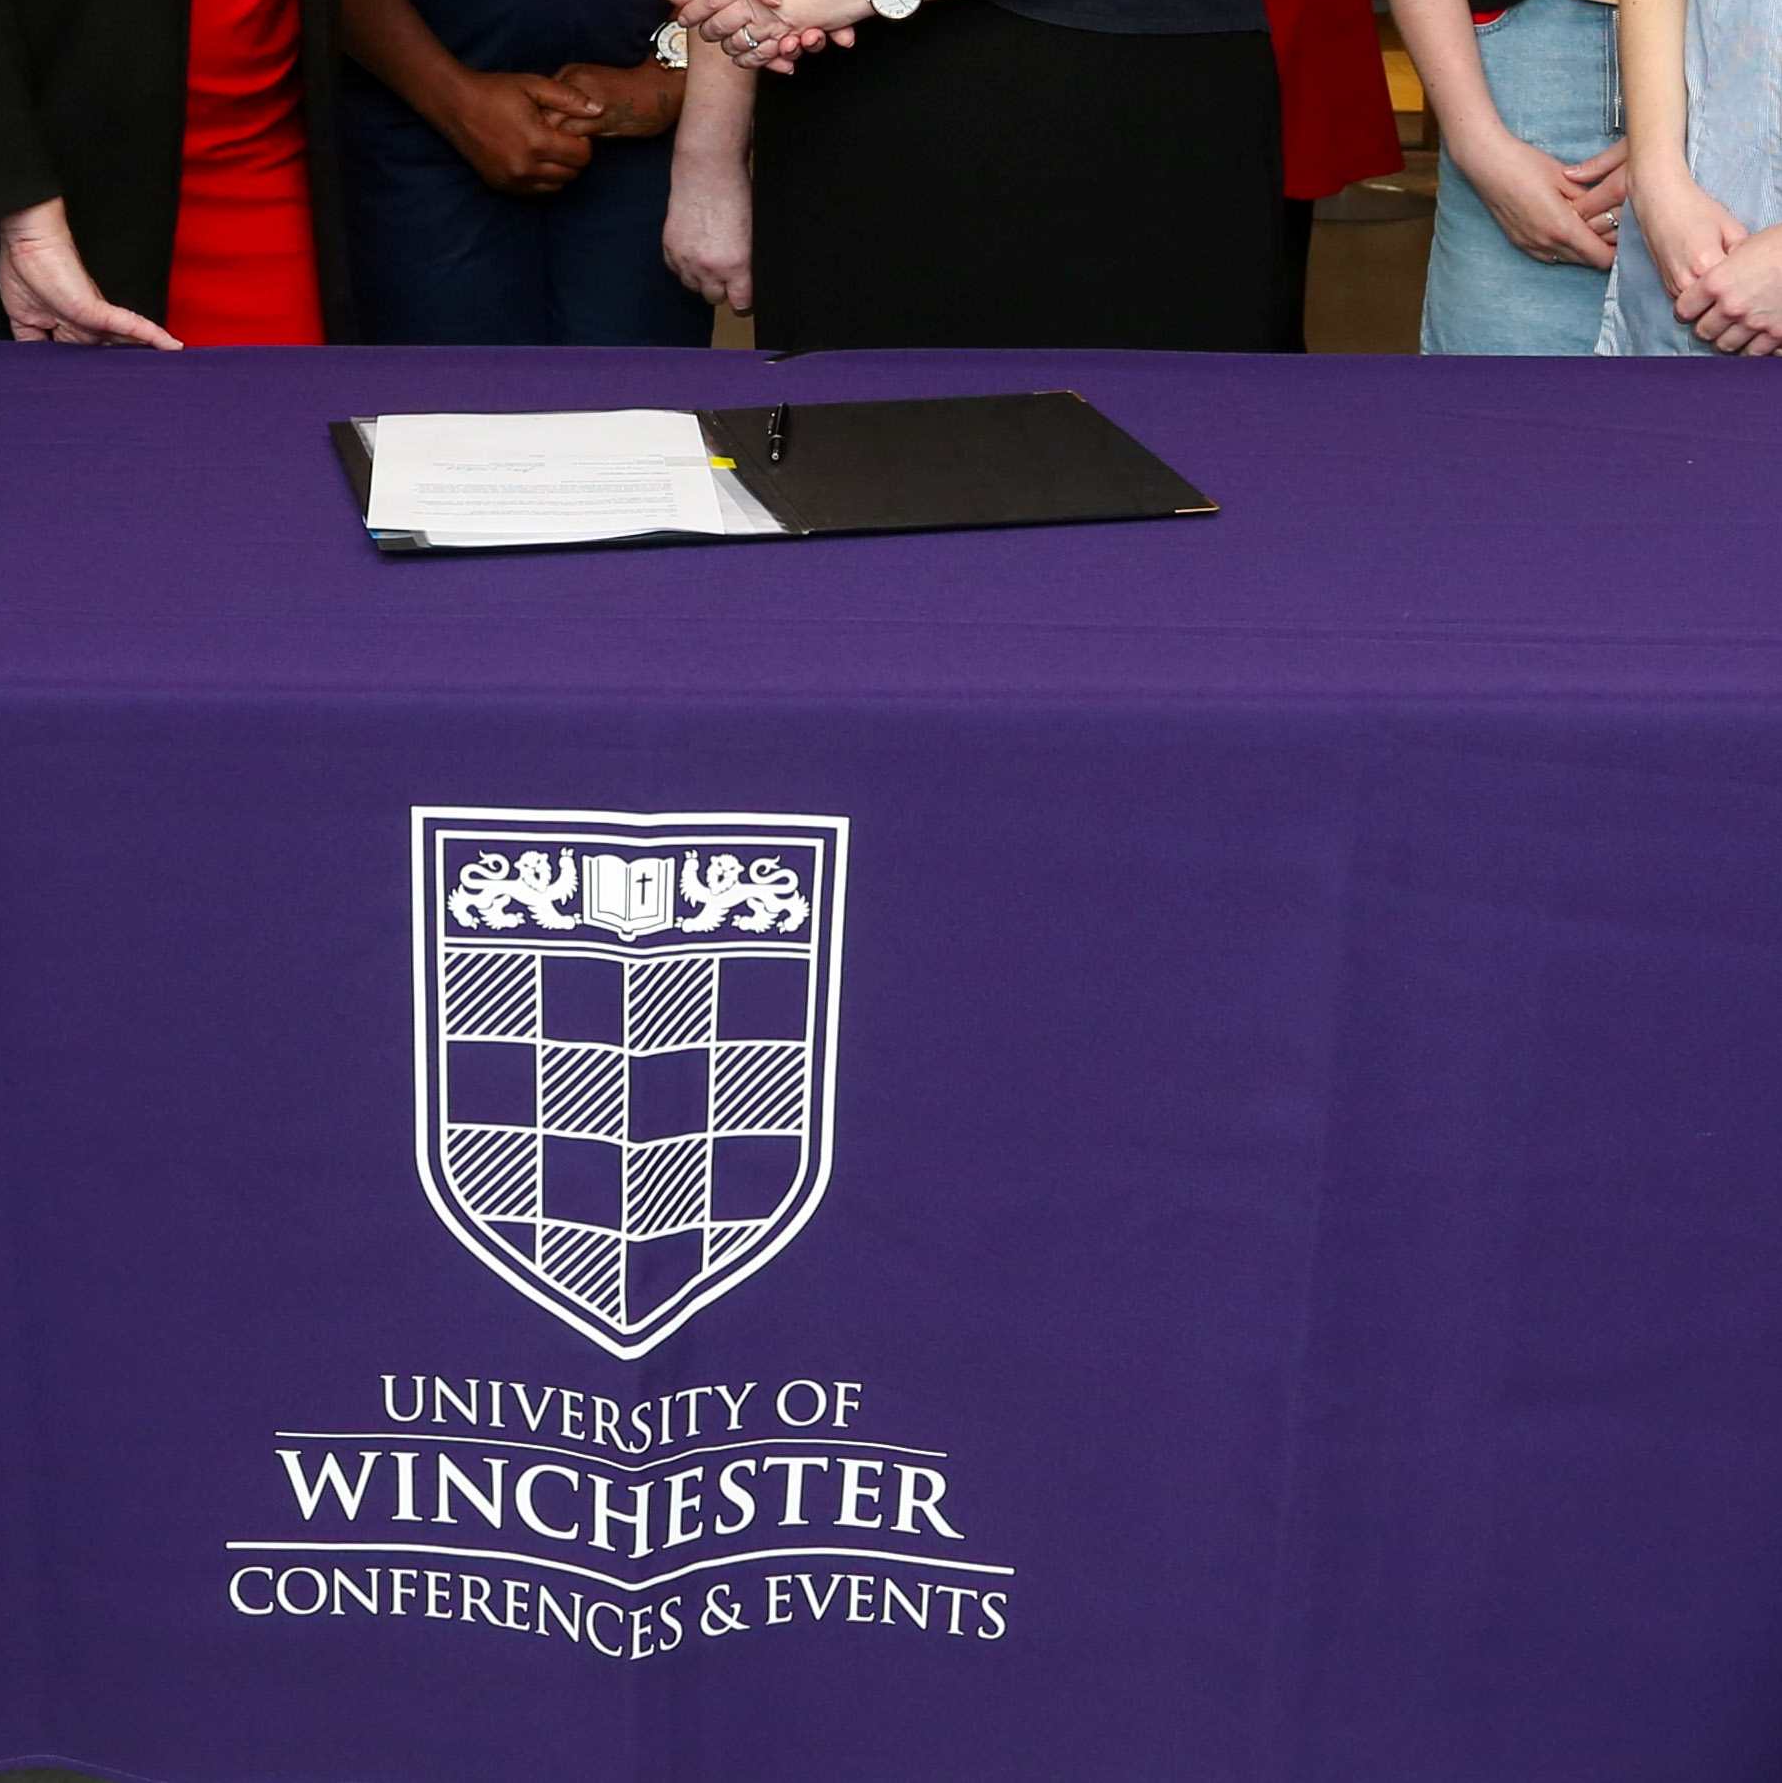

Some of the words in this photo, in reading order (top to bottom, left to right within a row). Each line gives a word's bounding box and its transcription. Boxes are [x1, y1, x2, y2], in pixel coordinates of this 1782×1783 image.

[380, 1374, 757, 1455] UNIVERSITY
[775, 1378, 863, 1430] OF
[275, 1449, 965, 1560] WINCHESTER
[227, 1566, 684, 1661] CONFERENCES
[698, 1584, 750, 1637] &
[765, 1573, 1010, 1641] EVENTS
